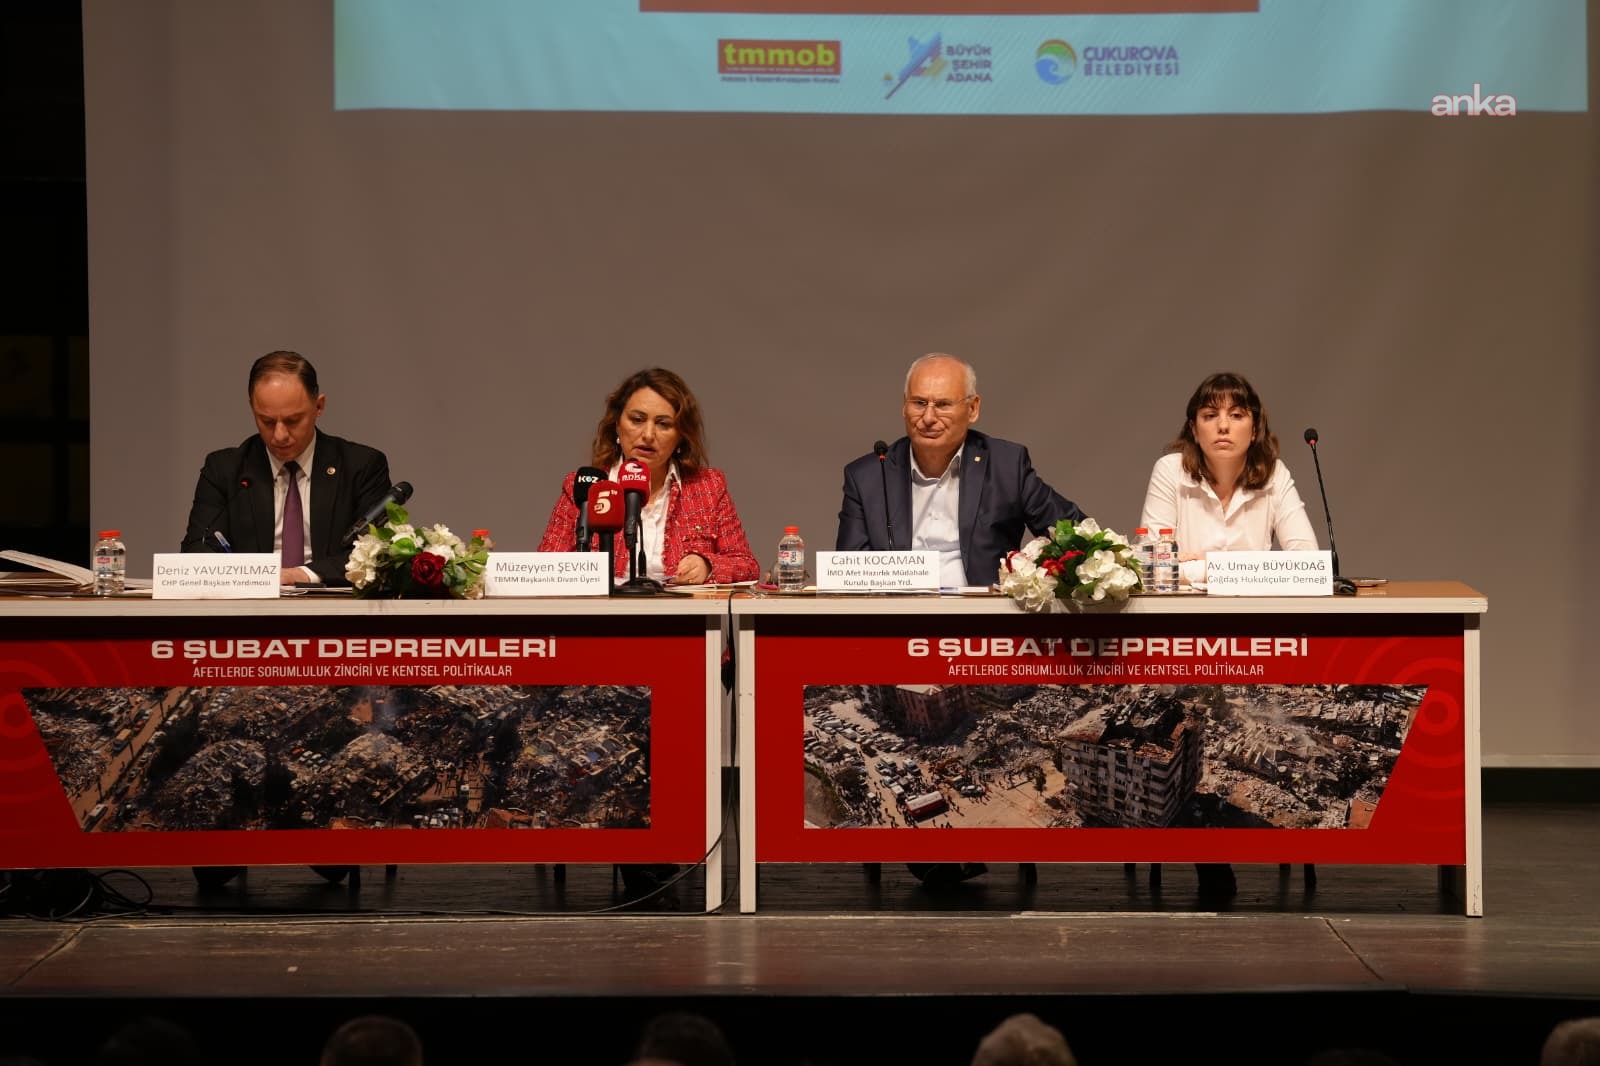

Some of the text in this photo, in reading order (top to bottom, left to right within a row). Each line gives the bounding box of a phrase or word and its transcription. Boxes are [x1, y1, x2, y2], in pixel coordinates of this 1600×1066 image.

[724, 43, 836, 66] tmmob
[946, 72, 993, 83] ADANA
[831, 555, 925, 565] Cahit KOCAMAN
[157, 565, 277, 576] Deniz YAVUZYILMAZ
[496, 560, 598, 574] Müzeyyen ŞEVKİN
[1207, 559, 1325, 573] Av. Umay BÜYÜKDAĞ
[845, 569, 861, 577] Afet
[892, 569, 929, 577] Müdahale
[179, 579, 202, 587] Genel
[203, 579, 231, 588] Başkan
[520, 576, 555, 585] Başkanlık
[579, 574, 601, 585] Üyesi
[843, 579, 913, 588] Kurulu Başkan Yrd.
[1241, 575, 1291, 585] Hukukçular
[1292, 575, 1328, 585] Derneği
[151, 636, 557, 664] 6 ŞUBAT DEPREMLERİ
[907, 634, 1309, 662] 6 ŞUBAT DEPREMLERİ
[193, 662, 513, 678] AFETLERDE SORUMLULUK ZİNCİRİ VE KENTSEL POLİTİKALAR
[948, 661, 1264, 676] AFETLERDE SORUMLULUK ZİNCİRİ VE KENTSEL POLİTİKALAR
